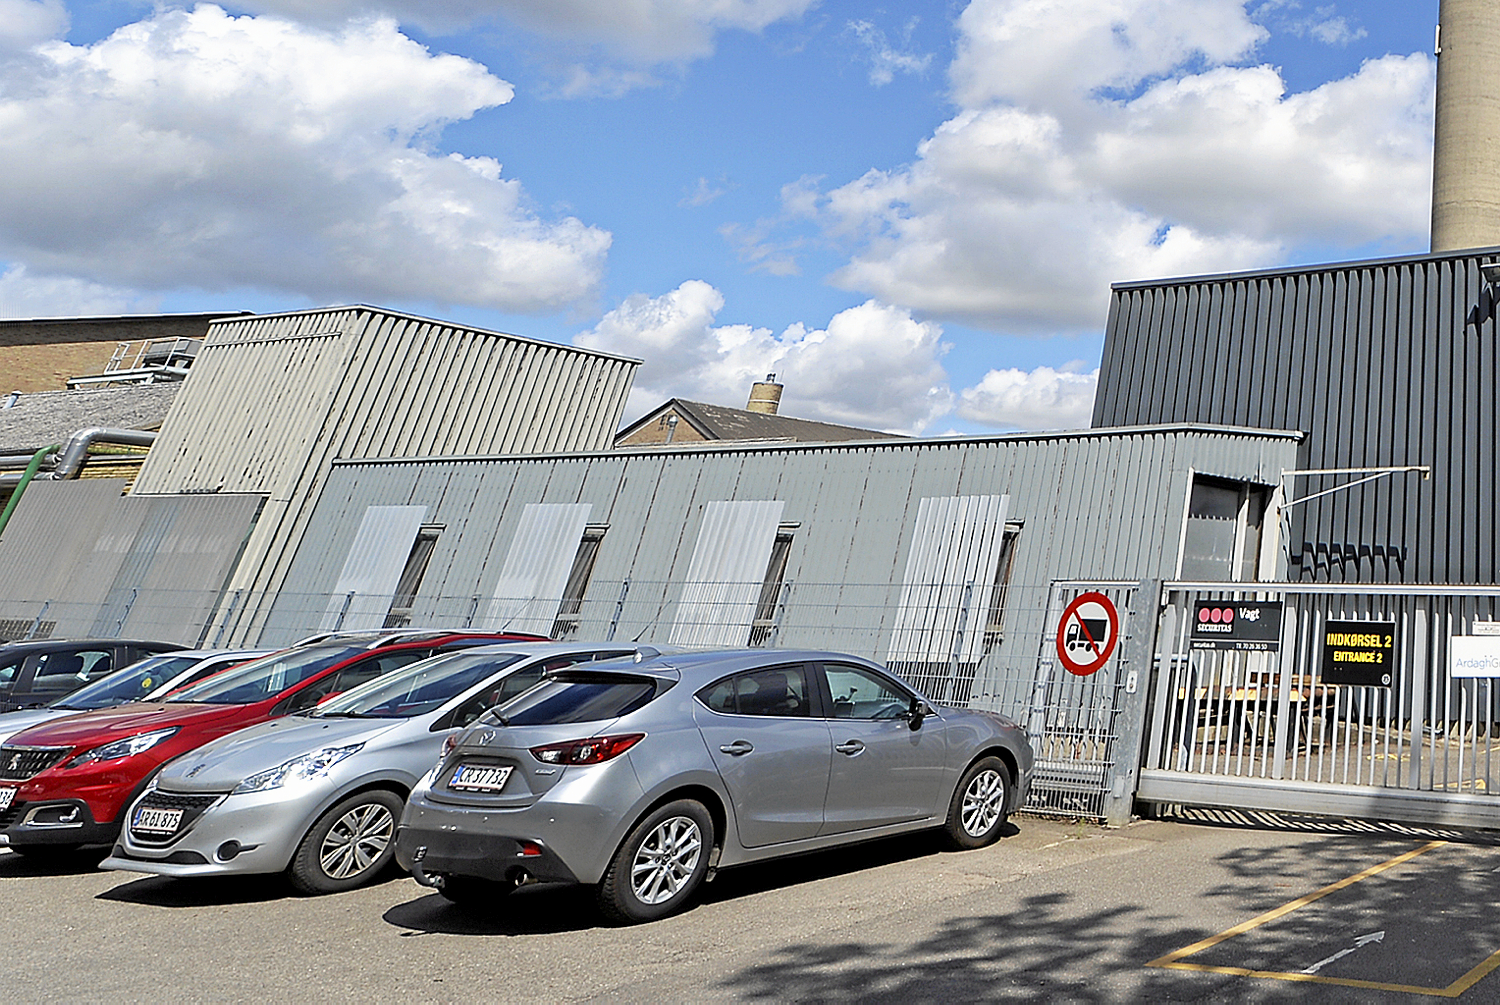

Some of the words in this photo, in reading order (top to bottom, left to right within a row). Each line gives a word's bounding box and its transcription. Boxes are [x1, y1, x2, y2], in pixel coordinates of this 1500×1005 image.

[1239, 607, 1260, 622] Vagt
[1197, 623, 1232, 633] SECURITAS
[1327, 633, 1383, 647] INDKØRSEL
[1384, 635, 1392, 648] 2
[1333, 651, 1375, 663] ENTRANCE
[1376, 652, 1383, 664] 2
